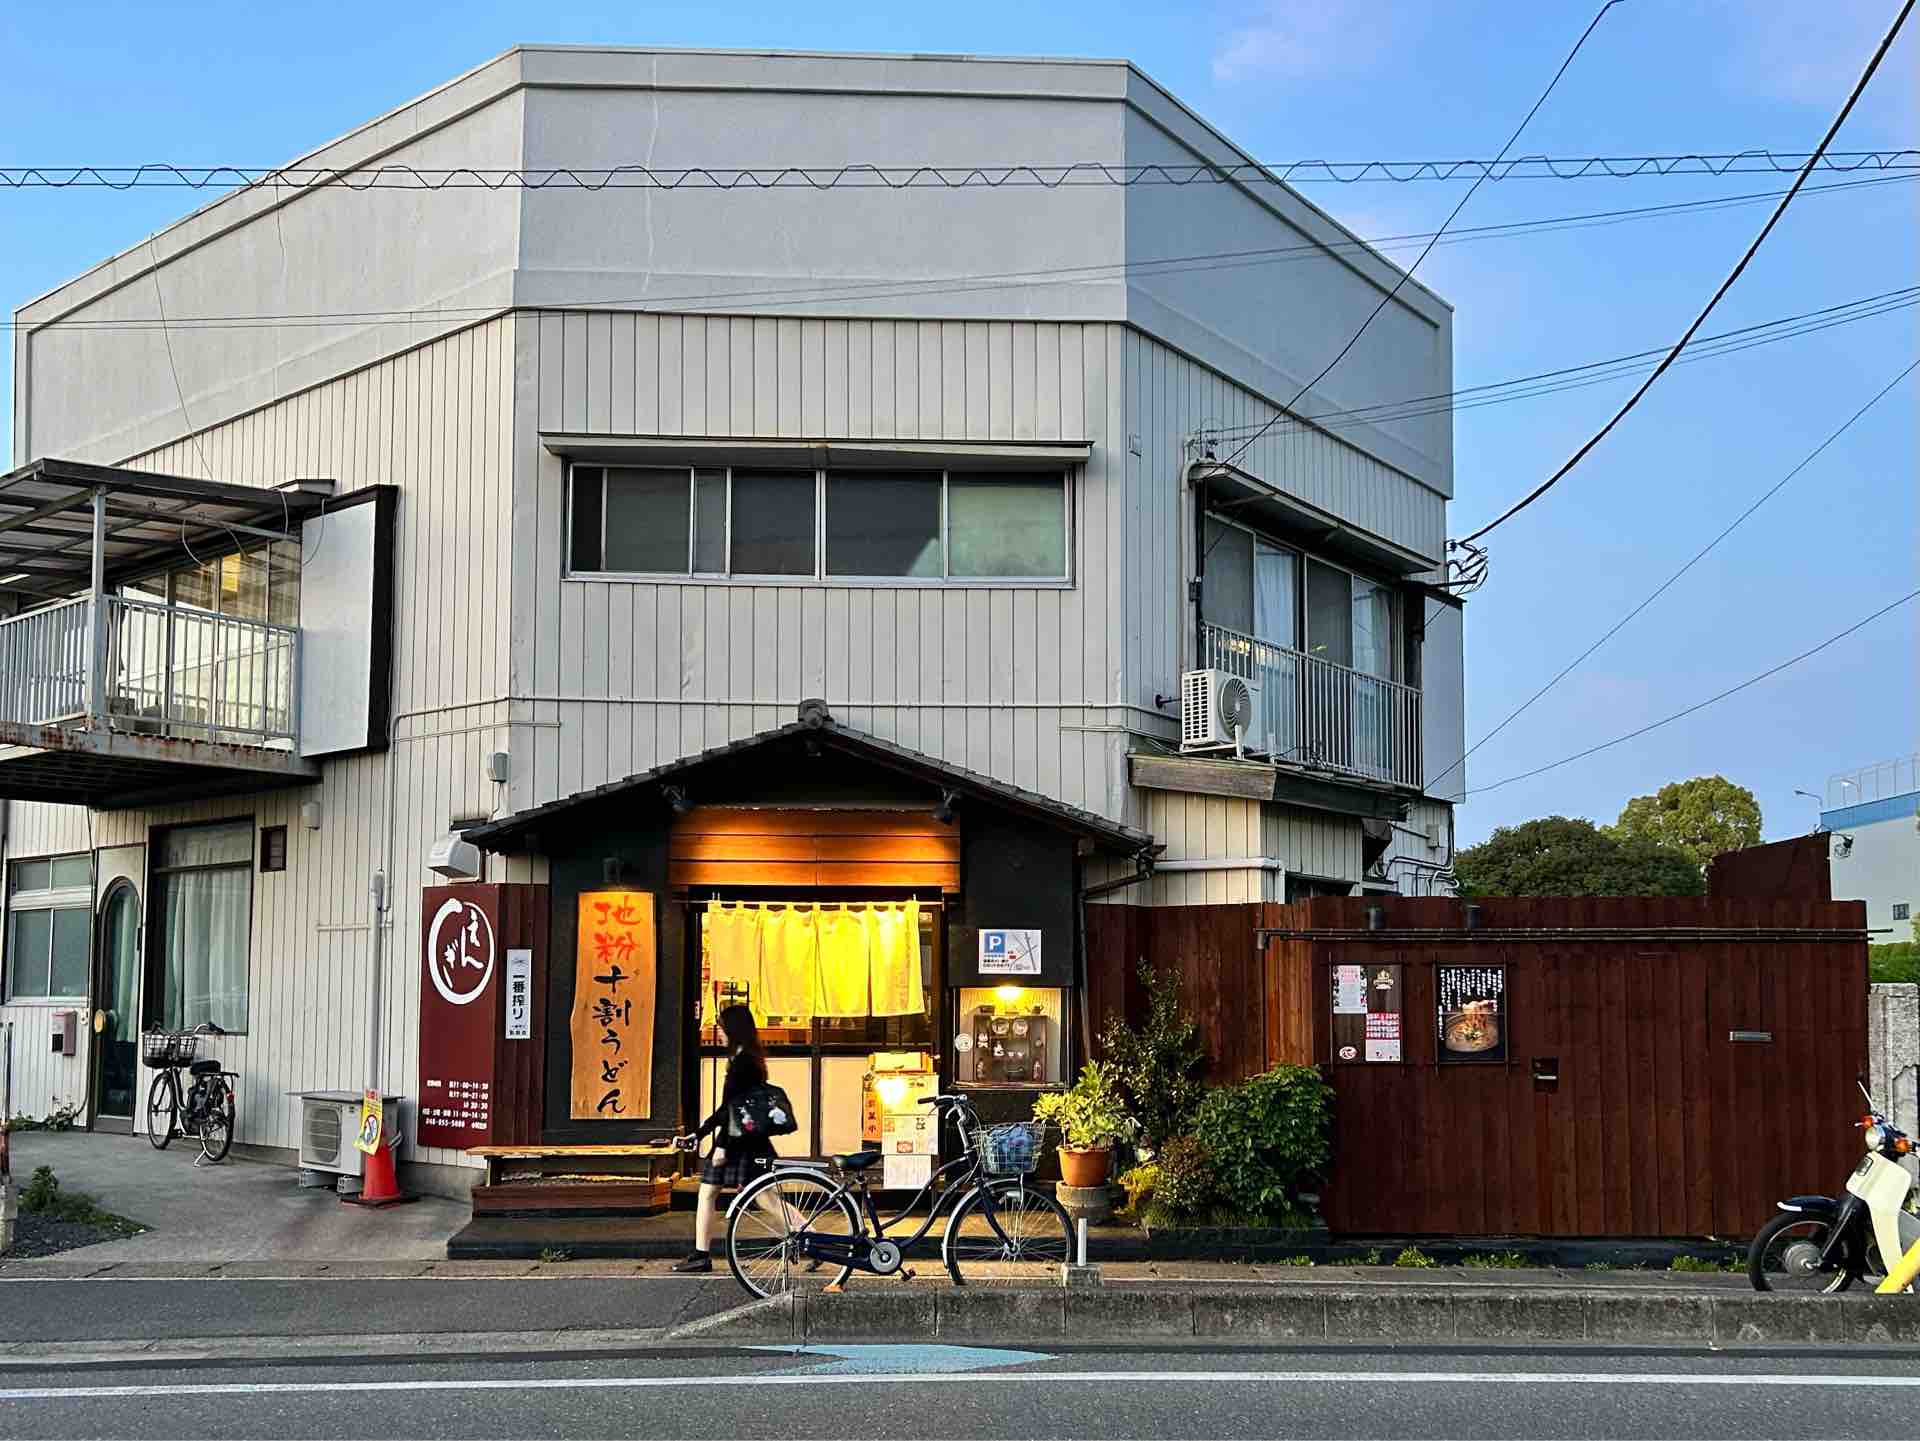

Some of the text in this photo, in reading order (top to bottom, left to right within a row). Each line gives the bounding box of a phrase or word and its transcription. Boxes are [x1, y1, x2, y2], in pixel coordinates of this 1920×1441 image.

[592, 896, 640, 1114] 地粉十割うどん
